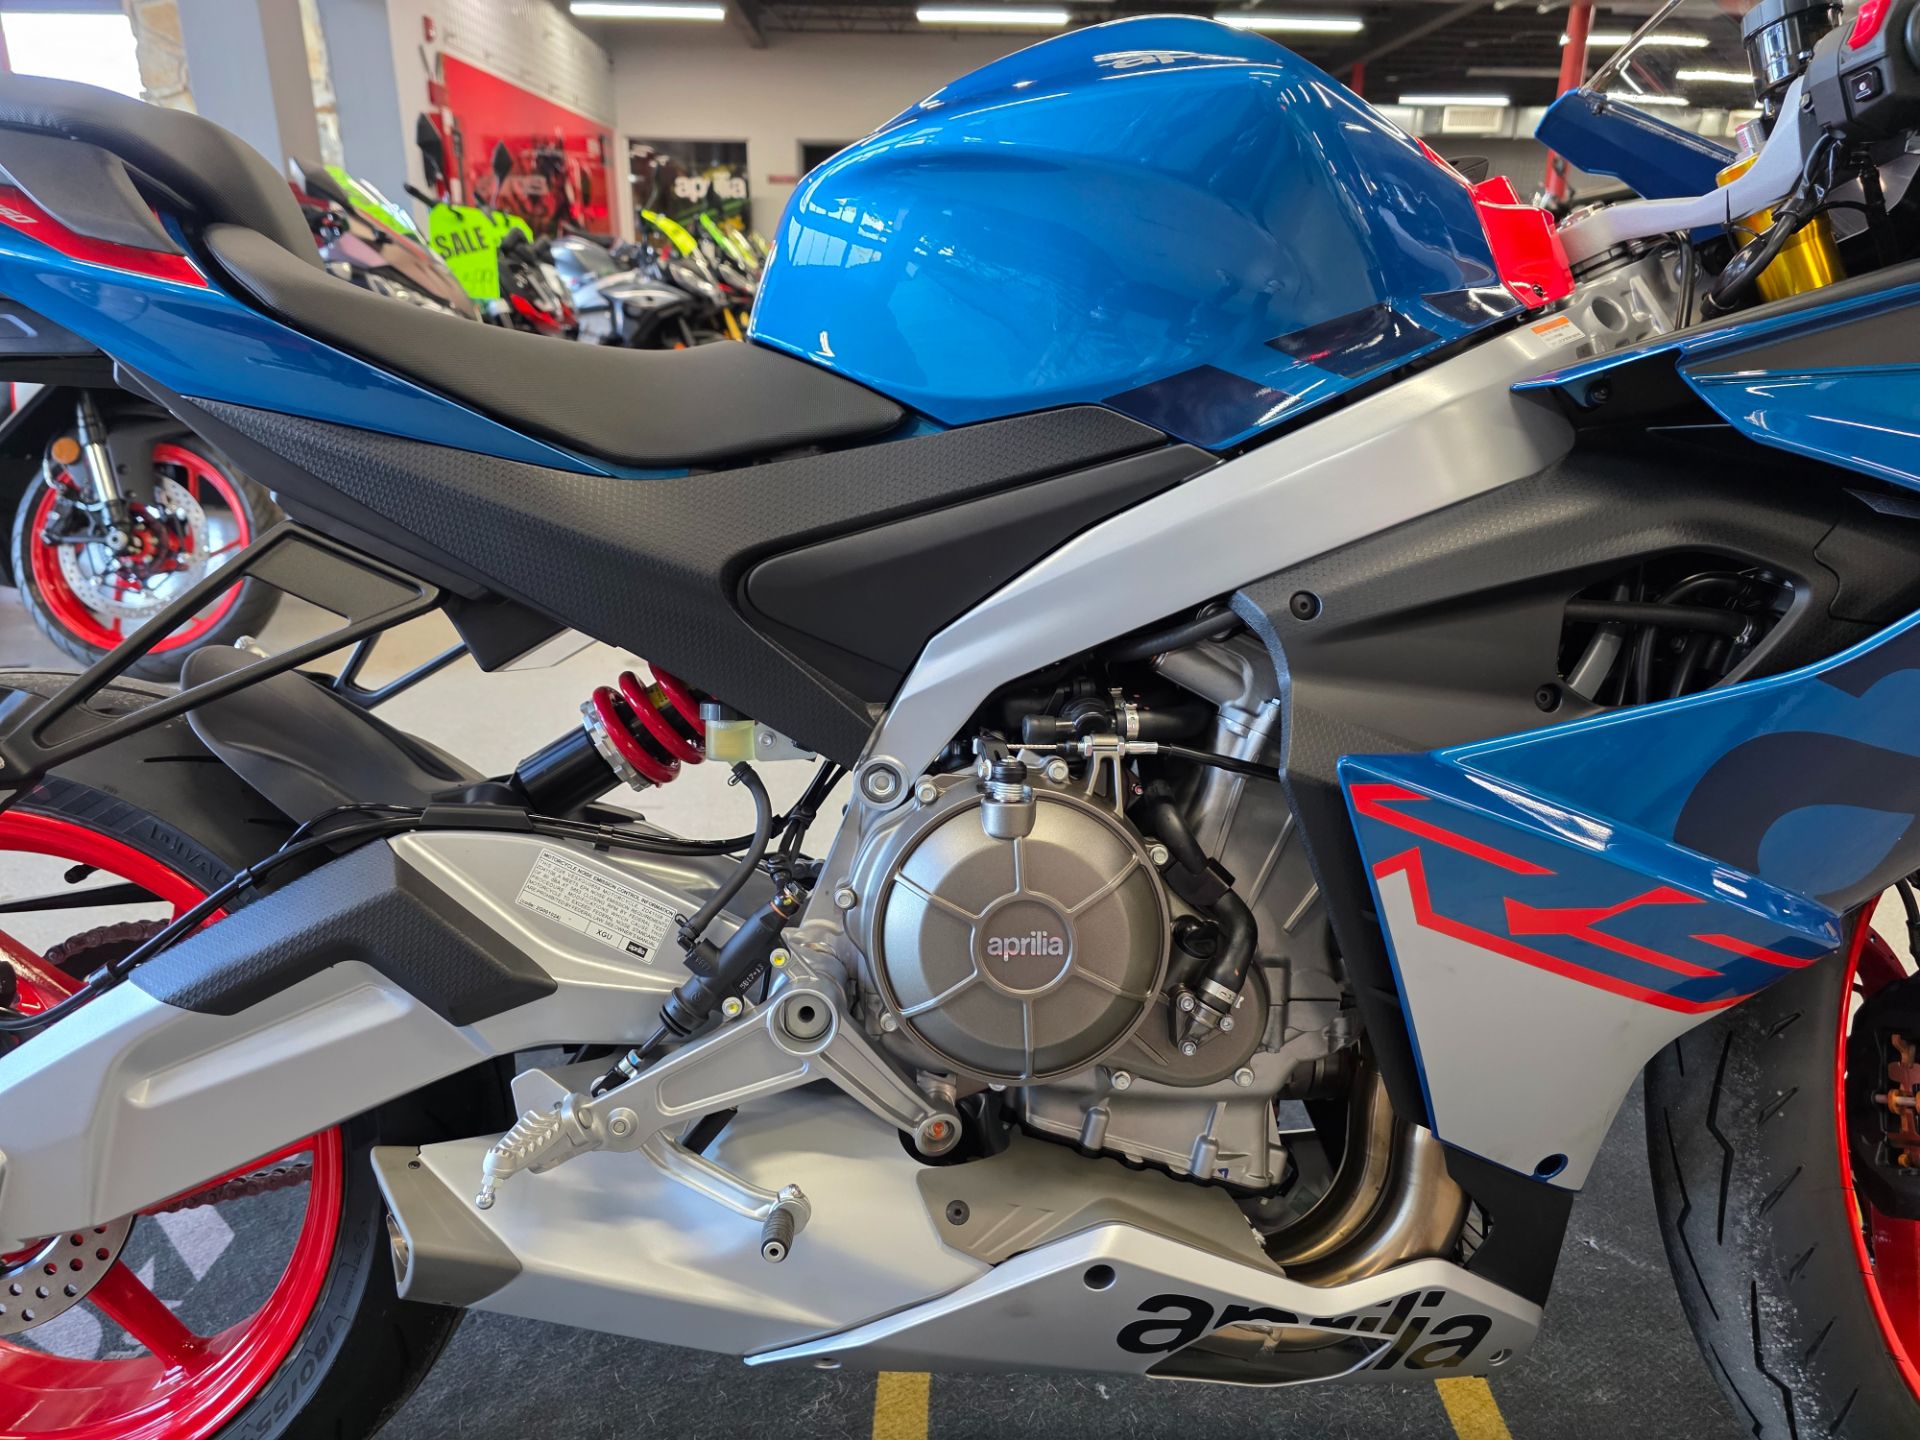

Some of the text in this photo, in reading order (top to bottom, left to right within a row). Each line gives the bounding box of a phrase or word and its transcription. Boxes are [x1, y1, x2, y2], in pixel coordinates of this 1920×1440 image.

[435, 227, 489, 259] SALE
[542, 851, 674, 916] MOTORCYCLE NOISE EMISSION CONTROL INFORMATION
[595, 928, 613, 940] XGU
[987, 930, 1063, 962] aprilia
